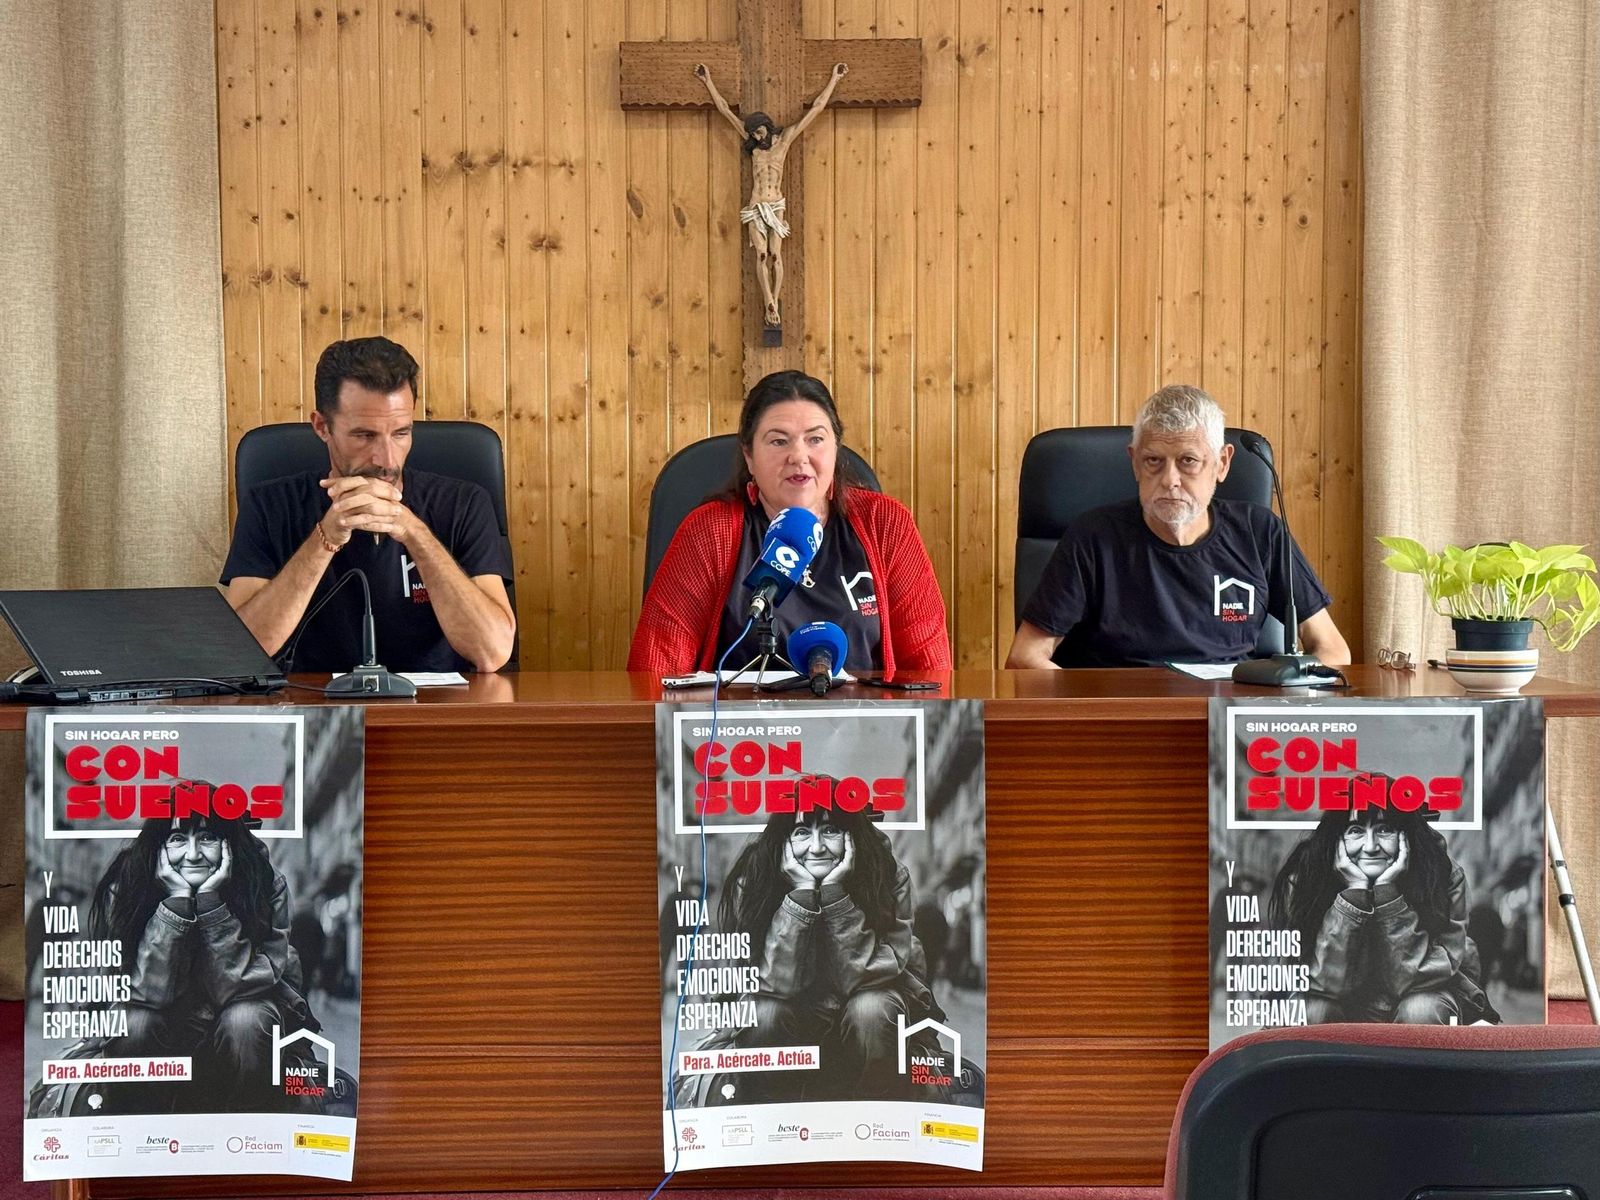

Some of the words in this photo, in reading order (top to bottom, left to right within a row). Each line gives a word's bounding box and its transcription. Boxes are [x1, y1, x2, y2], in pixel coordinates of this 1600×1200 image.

[770, 560, 791, 577] COPE
[60, 669, 102, 677] TOSHIBA
[65, 731, 88, 741] SIN
[90, 731, 140, 741] HOGAR
[143, 730, 180, 740] PERO
[692, 727, 713, 737] SIN
[717, 726, 765, 736] HOGAR
[767, 726, 802, 736] PERO
[1246, 723, 1268, 733] SIN
[1271, 722, 1319, 733] HOGAR
[1322, 722, 1357, 733] PERO
[65, 745, 179, 781] CON
[693, 740, 802, 777] CON
[1246, 736, 1357, 773] CON
[65, 780, 284, 820] SUEÑOS
[694, 775, 906, 816] SUEÑOS
[1247, 772, 1464, 812] SUEÑOS
[43, 871, 53, 899] Y
[674, 865, 684, 893] Y
[1225, 860, 1235, 888] Y
[43, 905, 79, 934] VIDA
[675, 899, 709, 927] VIDA
[1226, 895, 1260, 923] VIDA
[43, 940, 122, 969] DERECHOS
[676, 932, 750, 962] DERECHOS
[1226, 930, 1301, 958] DERECHOS
[43, 975, 131, 1004] EMOCIONES
[677, 966, 760, 997] EMOCIONES
[1226, 964, 1310, 992] EMOCIONES
[43, 1010, 128, 1039] ESPERANZA
[678, 1001, 758, 1031] ESPERANZA
[1226, 999, 1307, 1027] ESPERANZA
[48, 1064, 80, 1080] Para.
[84, 1062, 145, 1078] Acércate.
[148, 1060, 188, 1077] Actúa.
[285, 1067, 319, 1078] NADIE
[684, 1055, 714, 1071] Para.
[717, 1052, 775, 1069] Acércate.
[777, 1050, 816, 1066] Actúa.
[911, 1056, 945, 1067] NADIE
[911, 1066, 930, 1075] SIN
[285, 1077, 304, 1086] SIN
[285, 1086, 325, 1096] HOGAR
[911, 1075, 952, 1086] HOGAR
[146, 1135, 170, 1145] beste
[777, 1123, 800, 1133] beste
[872, 1129, 910, 1138] Faciam
[245, 1141, 283, 1150] Faciam
